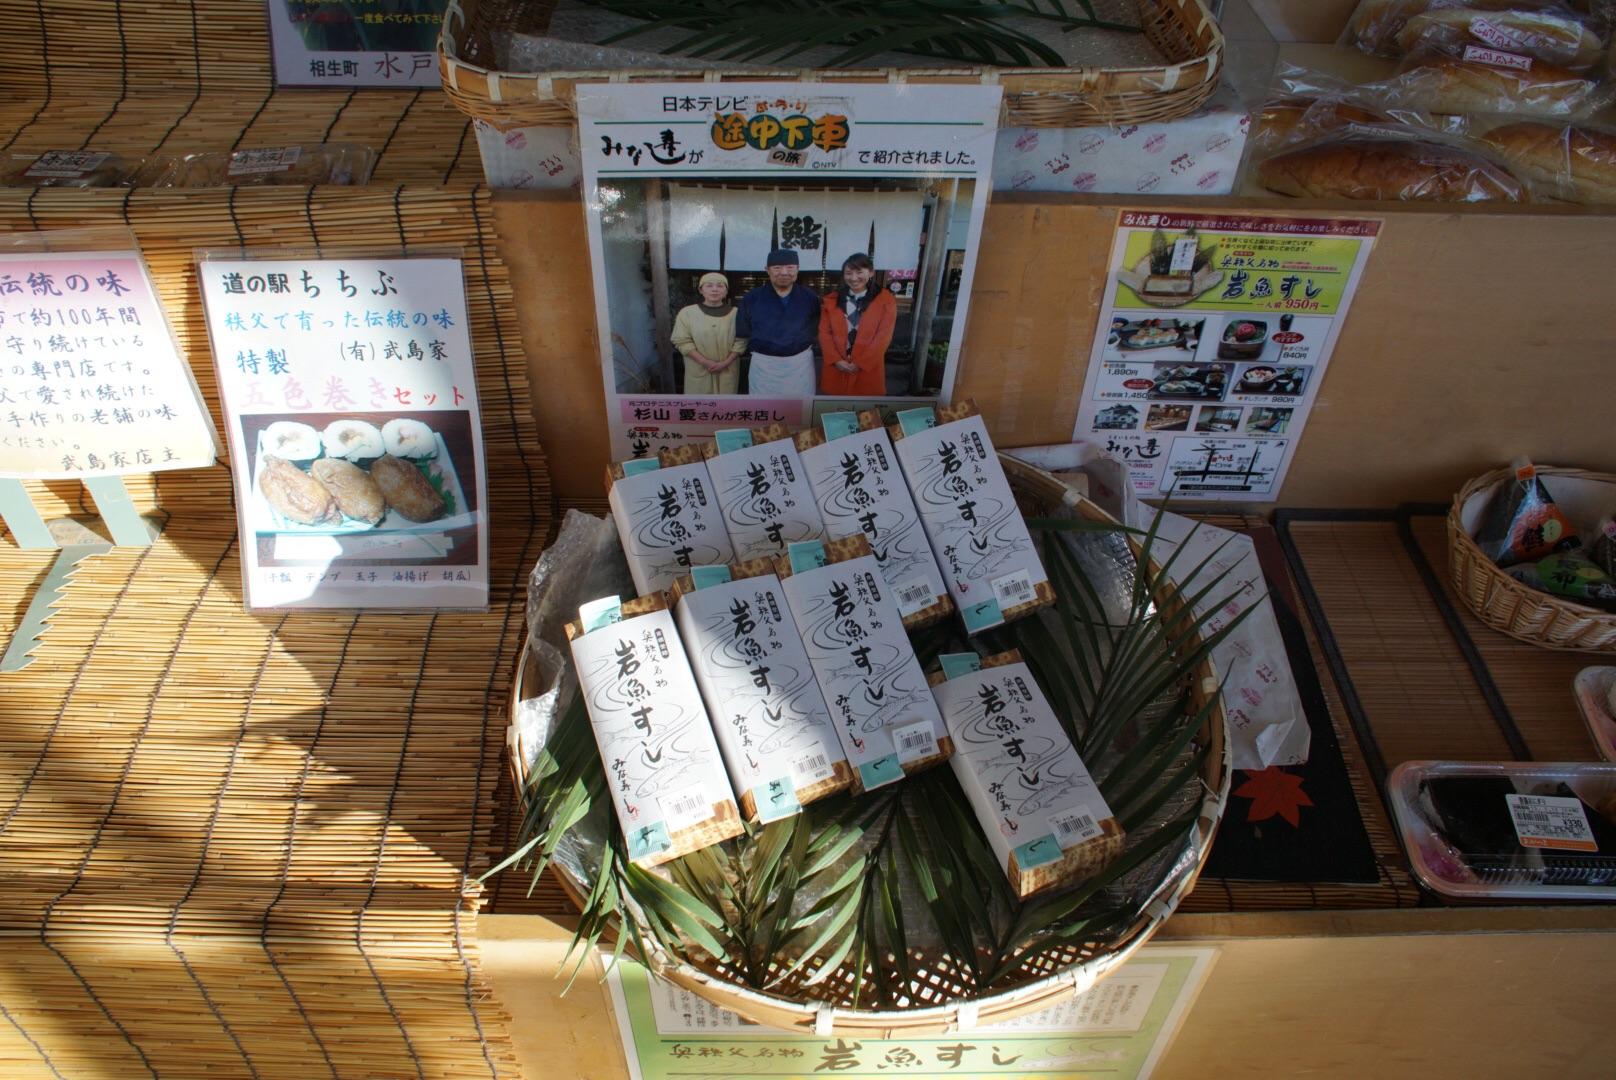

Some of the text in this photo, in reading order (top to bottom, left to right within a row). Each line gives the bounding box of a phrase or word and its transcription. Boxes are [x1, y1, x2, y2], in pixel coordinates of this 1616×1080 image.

[310, 53, 432, 79] 相生町 水戸
[662, 96, 748, 112] 日本テレビ
[712, 112, 849, 153] 途中下車
[772, 150, 801, 164] の旅
[858, 150, 977, 165] で紹介されました。
[0, 269, 131, 297] 伝統の味
[222, 269, 398, 298] 道の駅ちちぶ
[1221, 270, 1322, 300] 岩魚すし
[1285, 299, 1319, 311] 950円
[224, 308, 455, 332] 秩父で育った伝統の味
[6, 333, 144, 354] 守り続けている
[237, 349, 290, 376] 特製
[239, 375, 465, 412] 五色巻きセット
[634, 408, 670, 421] 杉山
[61, 447, 181, 471] 武島家店主
[747, 462, 785, 556] 岩魚す
[840, 451, 889, 562] 岩魚すし
[938, 439, 988, 551] 岩魚すし
[829, 580, 885, 701] 岩魚すし
[730, 597, 782, 721] 岩魚すし
[615, 638, 662, 763] 岩魚すし
[978, 683, 1040, 786] 岩魚すし
[669, 1038, 1024, 1072] 奥秩父名物 岩魚すし
